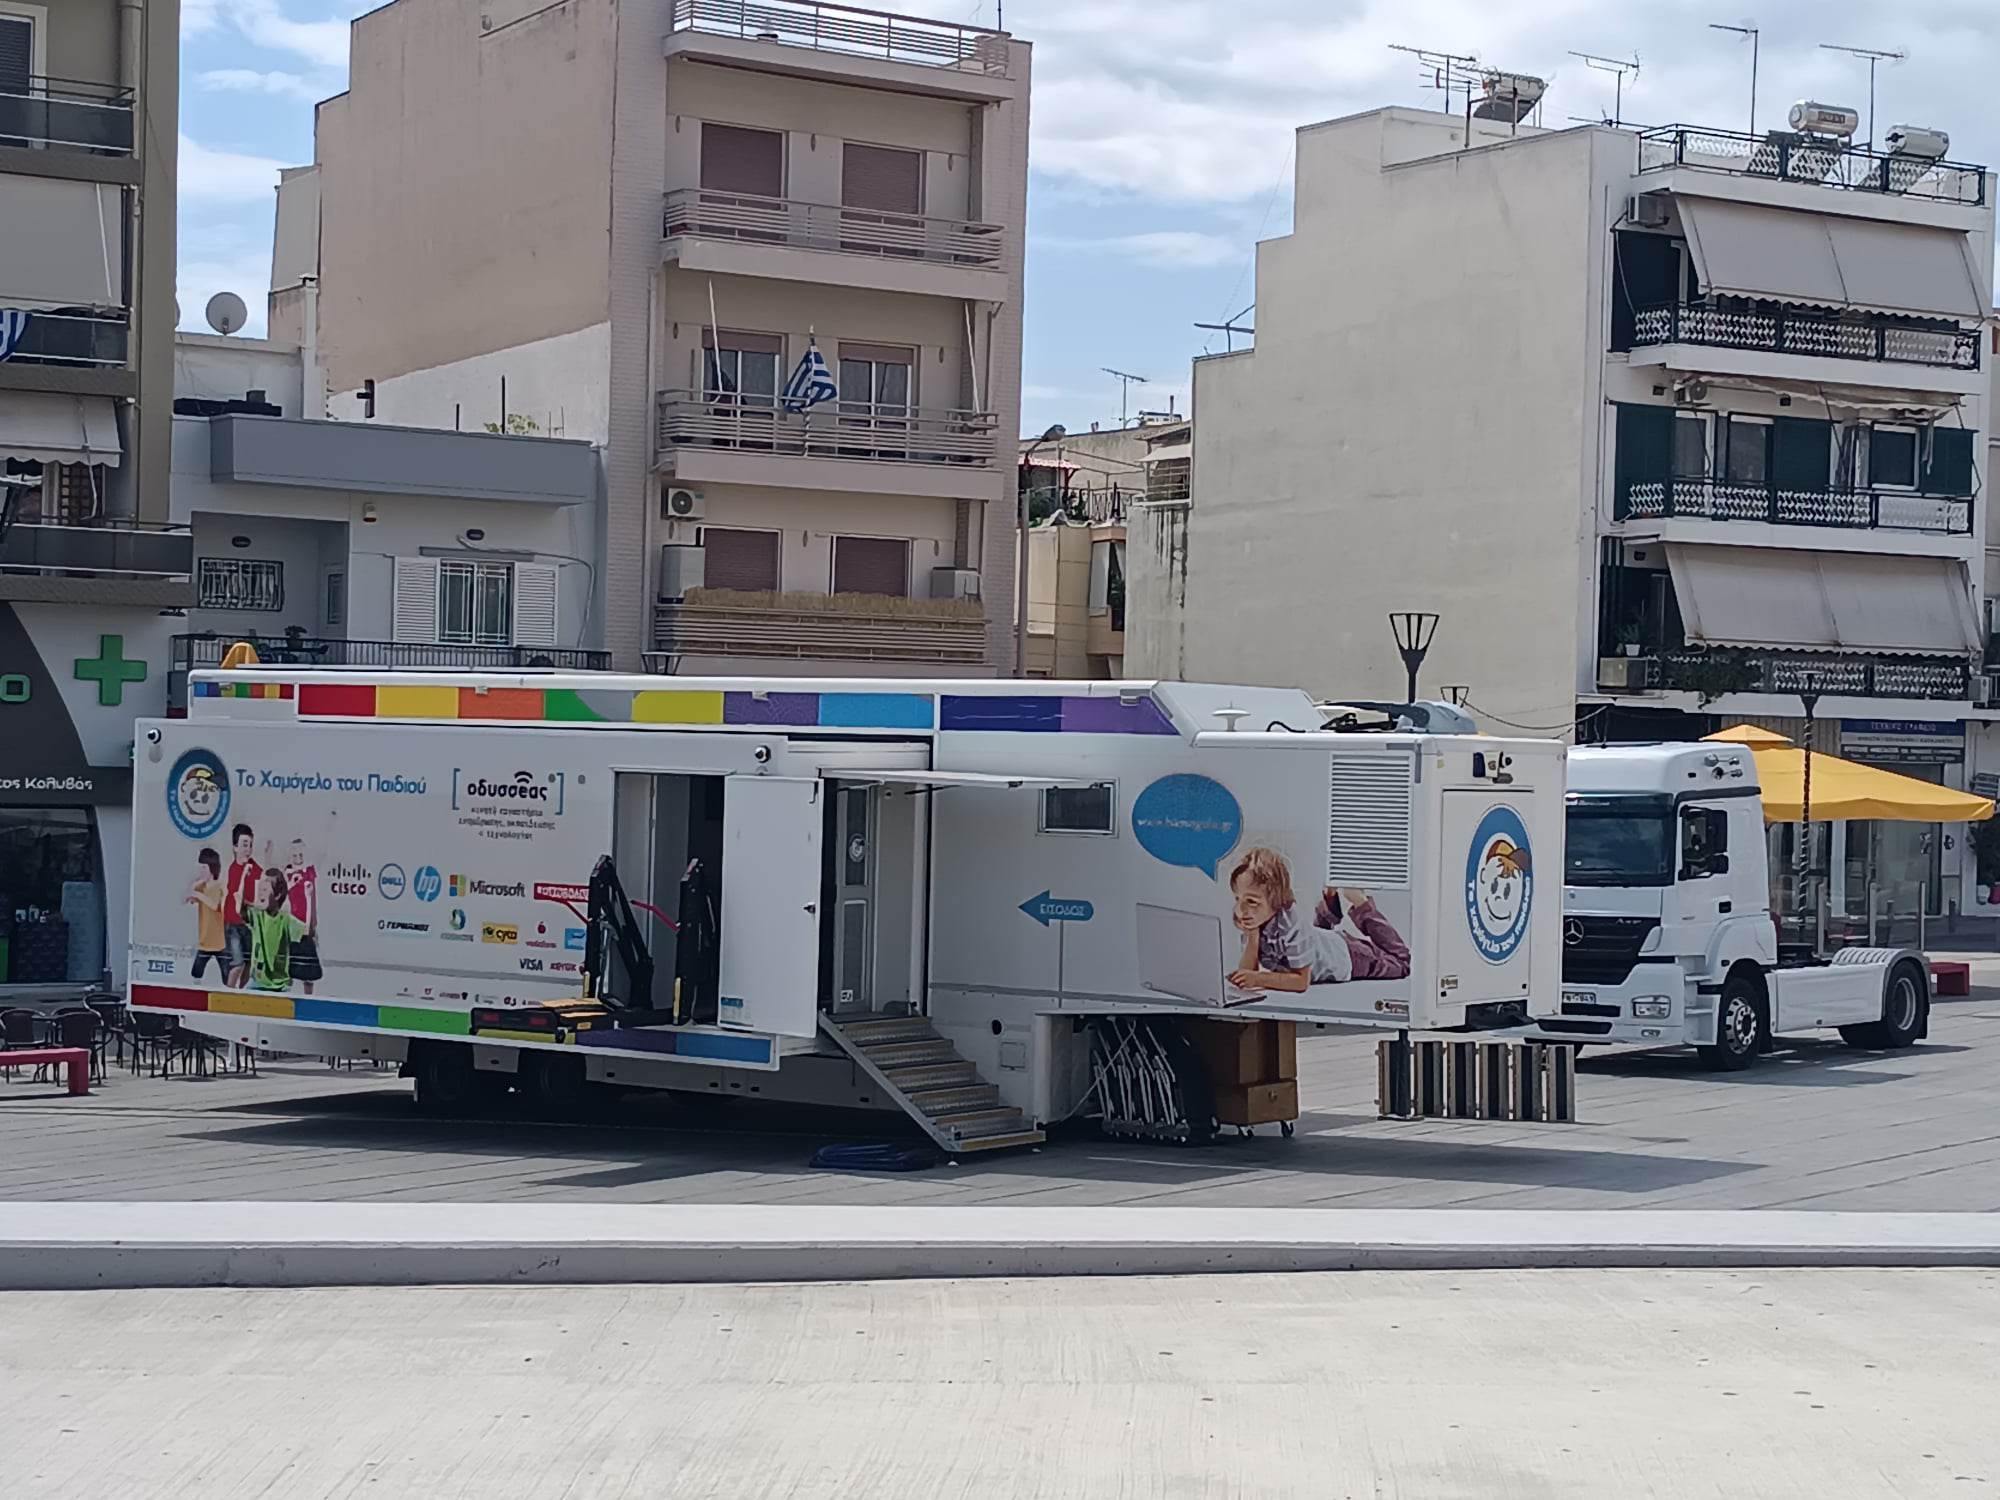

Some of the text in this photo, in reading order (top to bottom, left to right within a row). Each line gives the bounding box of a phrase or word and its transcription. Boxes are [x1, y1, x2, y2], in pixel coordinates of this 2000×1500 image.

[235, 769, 427, 795] Το Χαμόγελο του Παιδιού
[415, 866, 440, 901] hp
[470, 880, 526, 897] Microsoft
[519, 958, 544, 971] VISA
